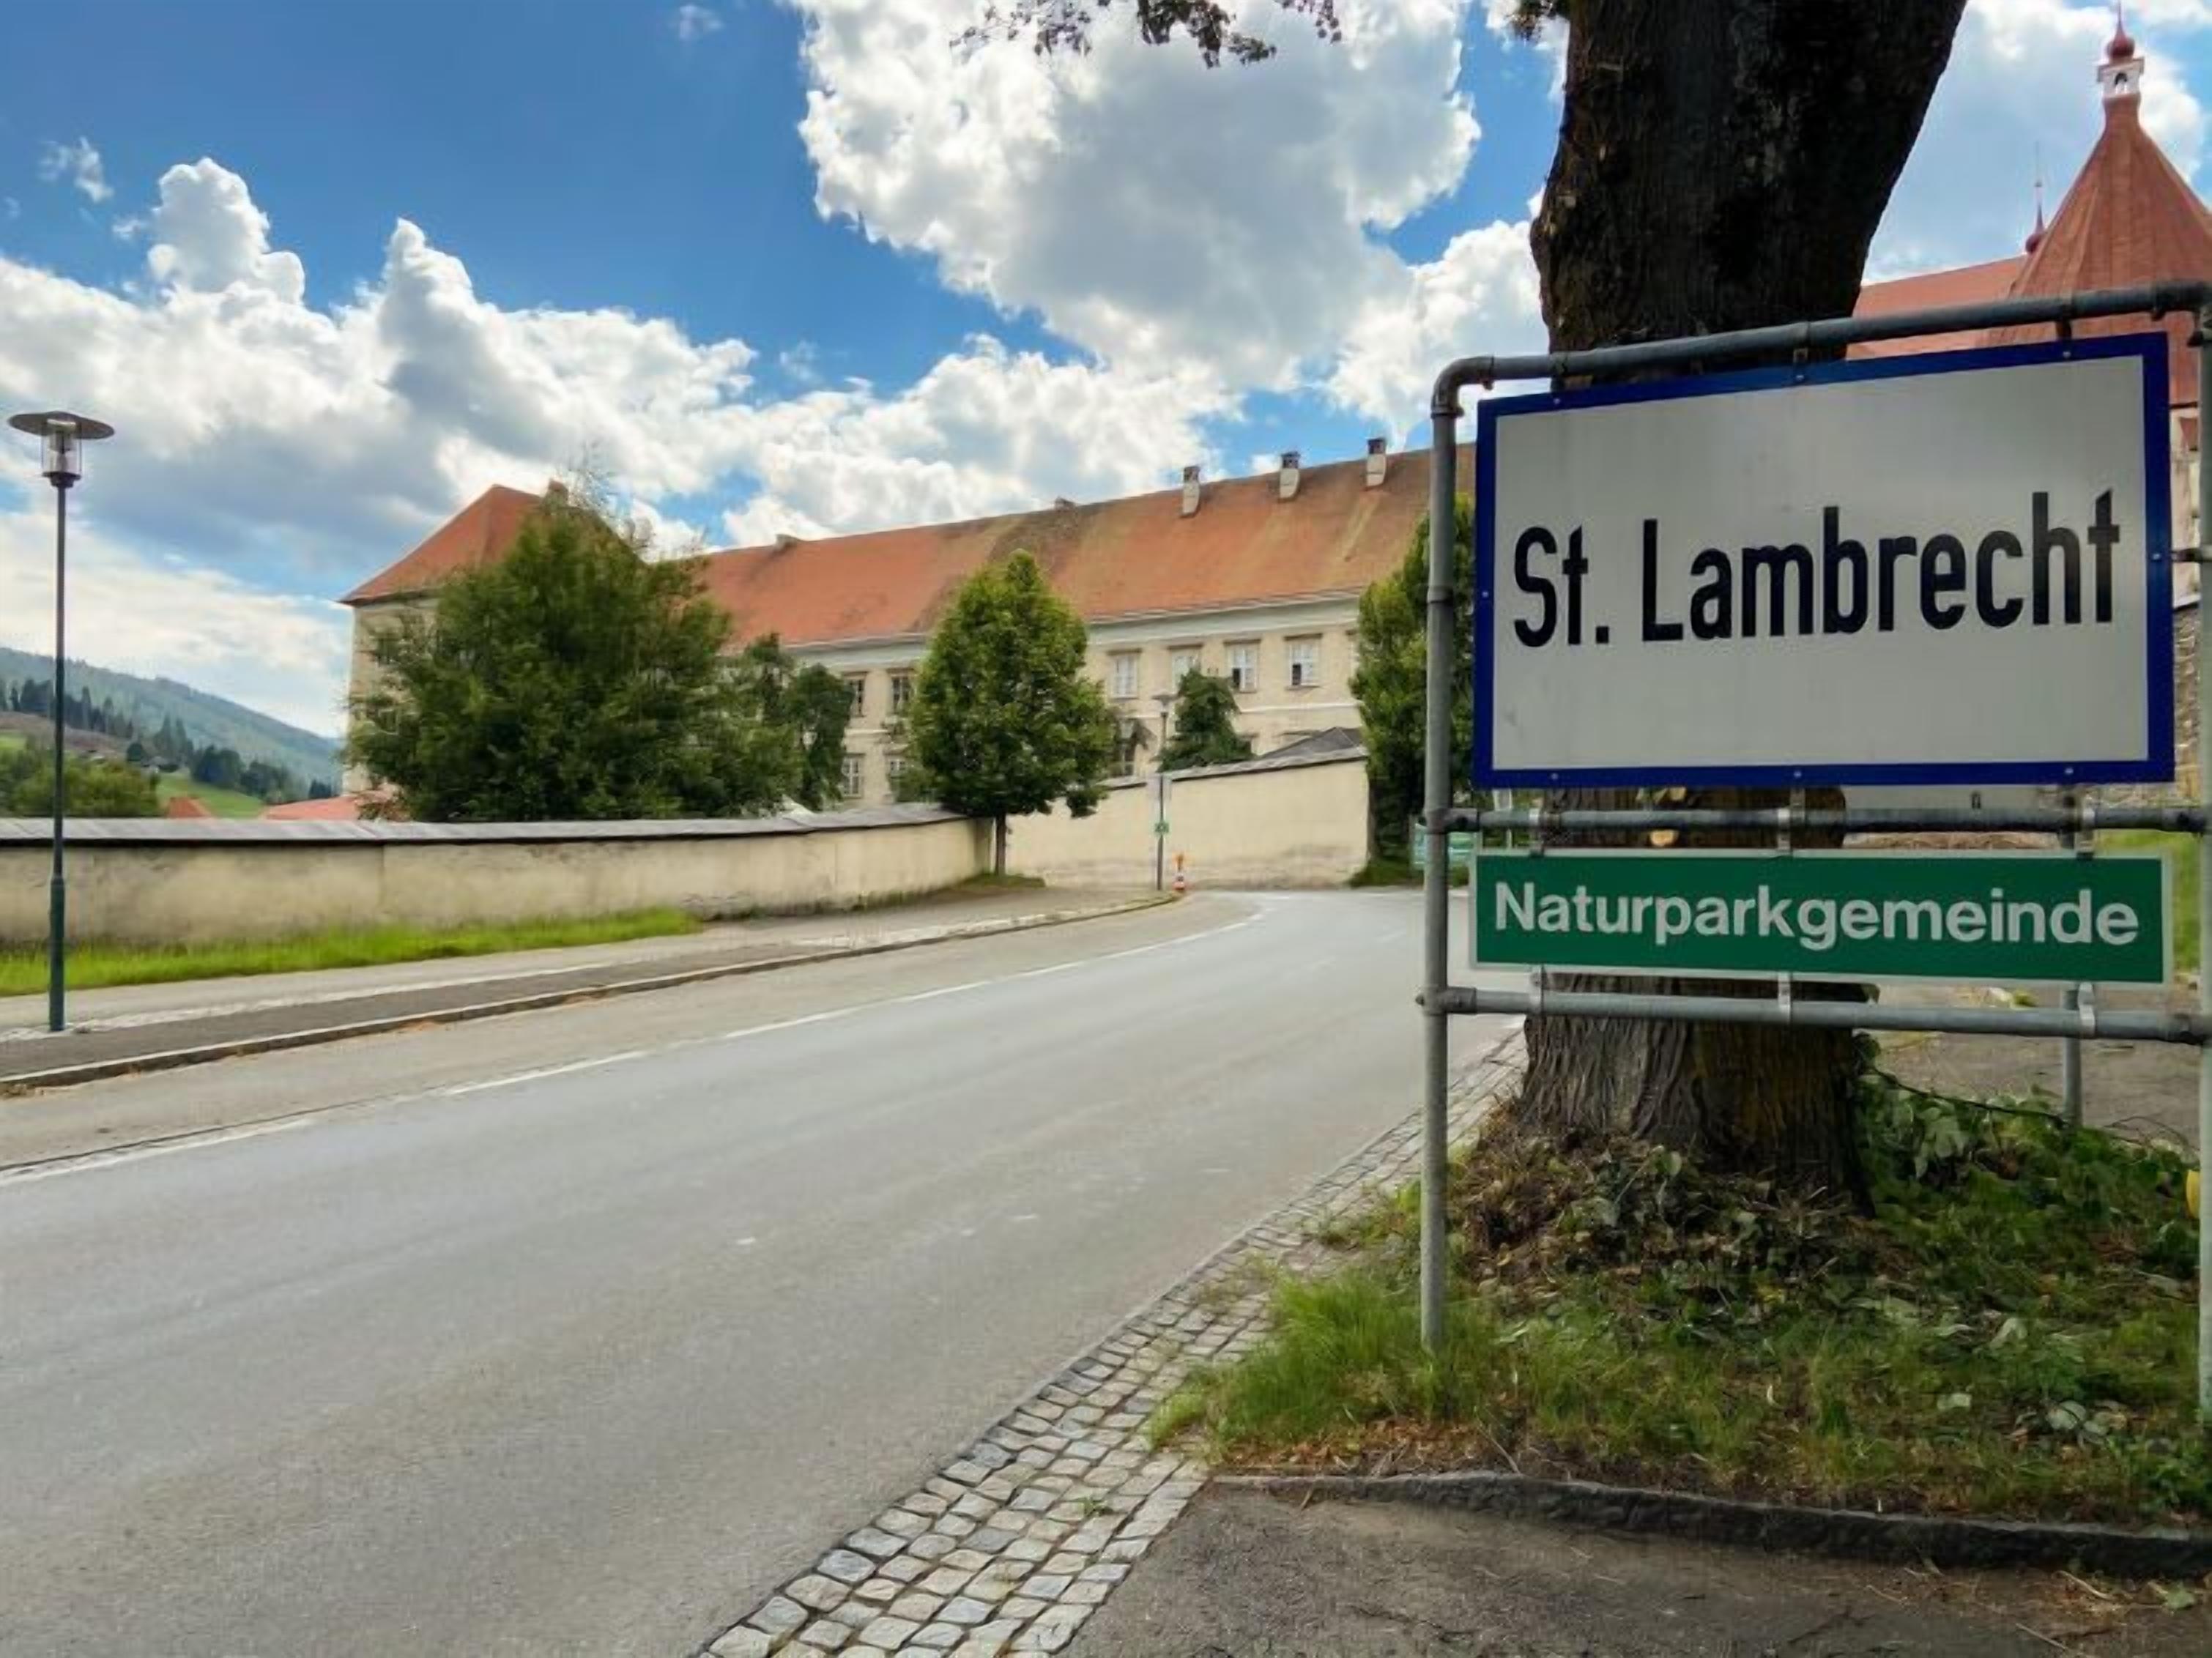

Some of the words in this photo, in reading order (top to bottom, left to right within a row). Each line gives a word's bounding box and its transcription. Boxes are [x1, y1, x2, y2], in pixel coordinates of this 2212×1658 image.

[1513, 524, 1611, 648] St.
[1641, 487, 2121, 643] Lambrecht
[1494, 882, 2139, 951] Naturparkgemeinde
